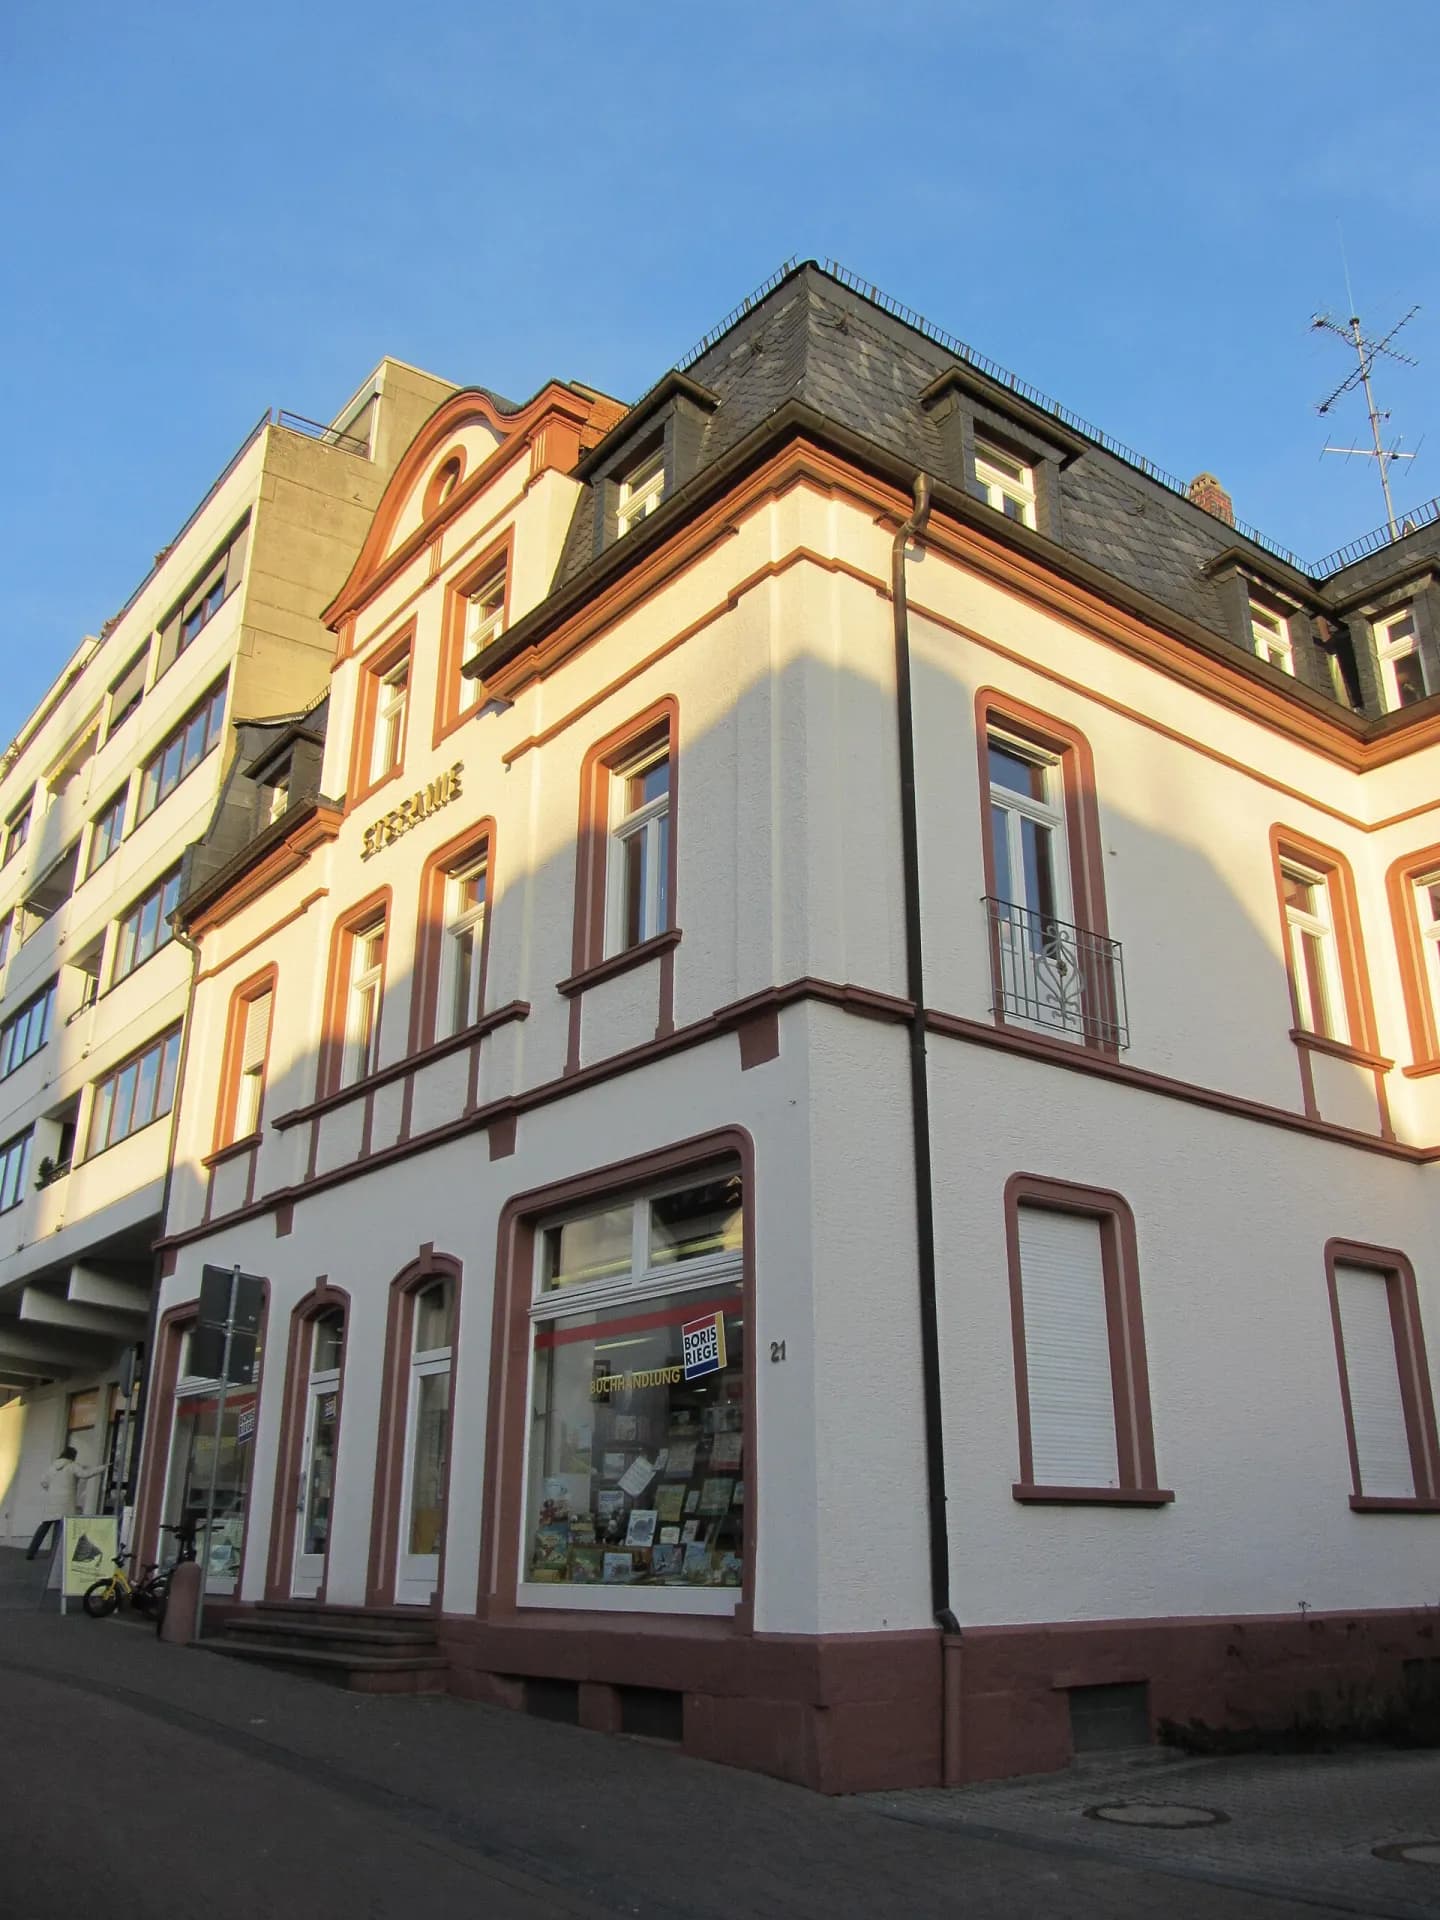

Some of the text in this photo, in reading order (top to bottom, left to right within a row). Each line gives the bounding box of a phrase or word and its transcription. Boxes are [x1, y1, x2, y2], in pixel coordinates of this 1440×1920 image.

[684, 1326, 717, 1351] BORIS
[685, 1342, 718, 1366] RIEGE
[770, 1340, 786, 1363] 21
[591, 1369, 681, 1394] BUCHHANDLUNG
